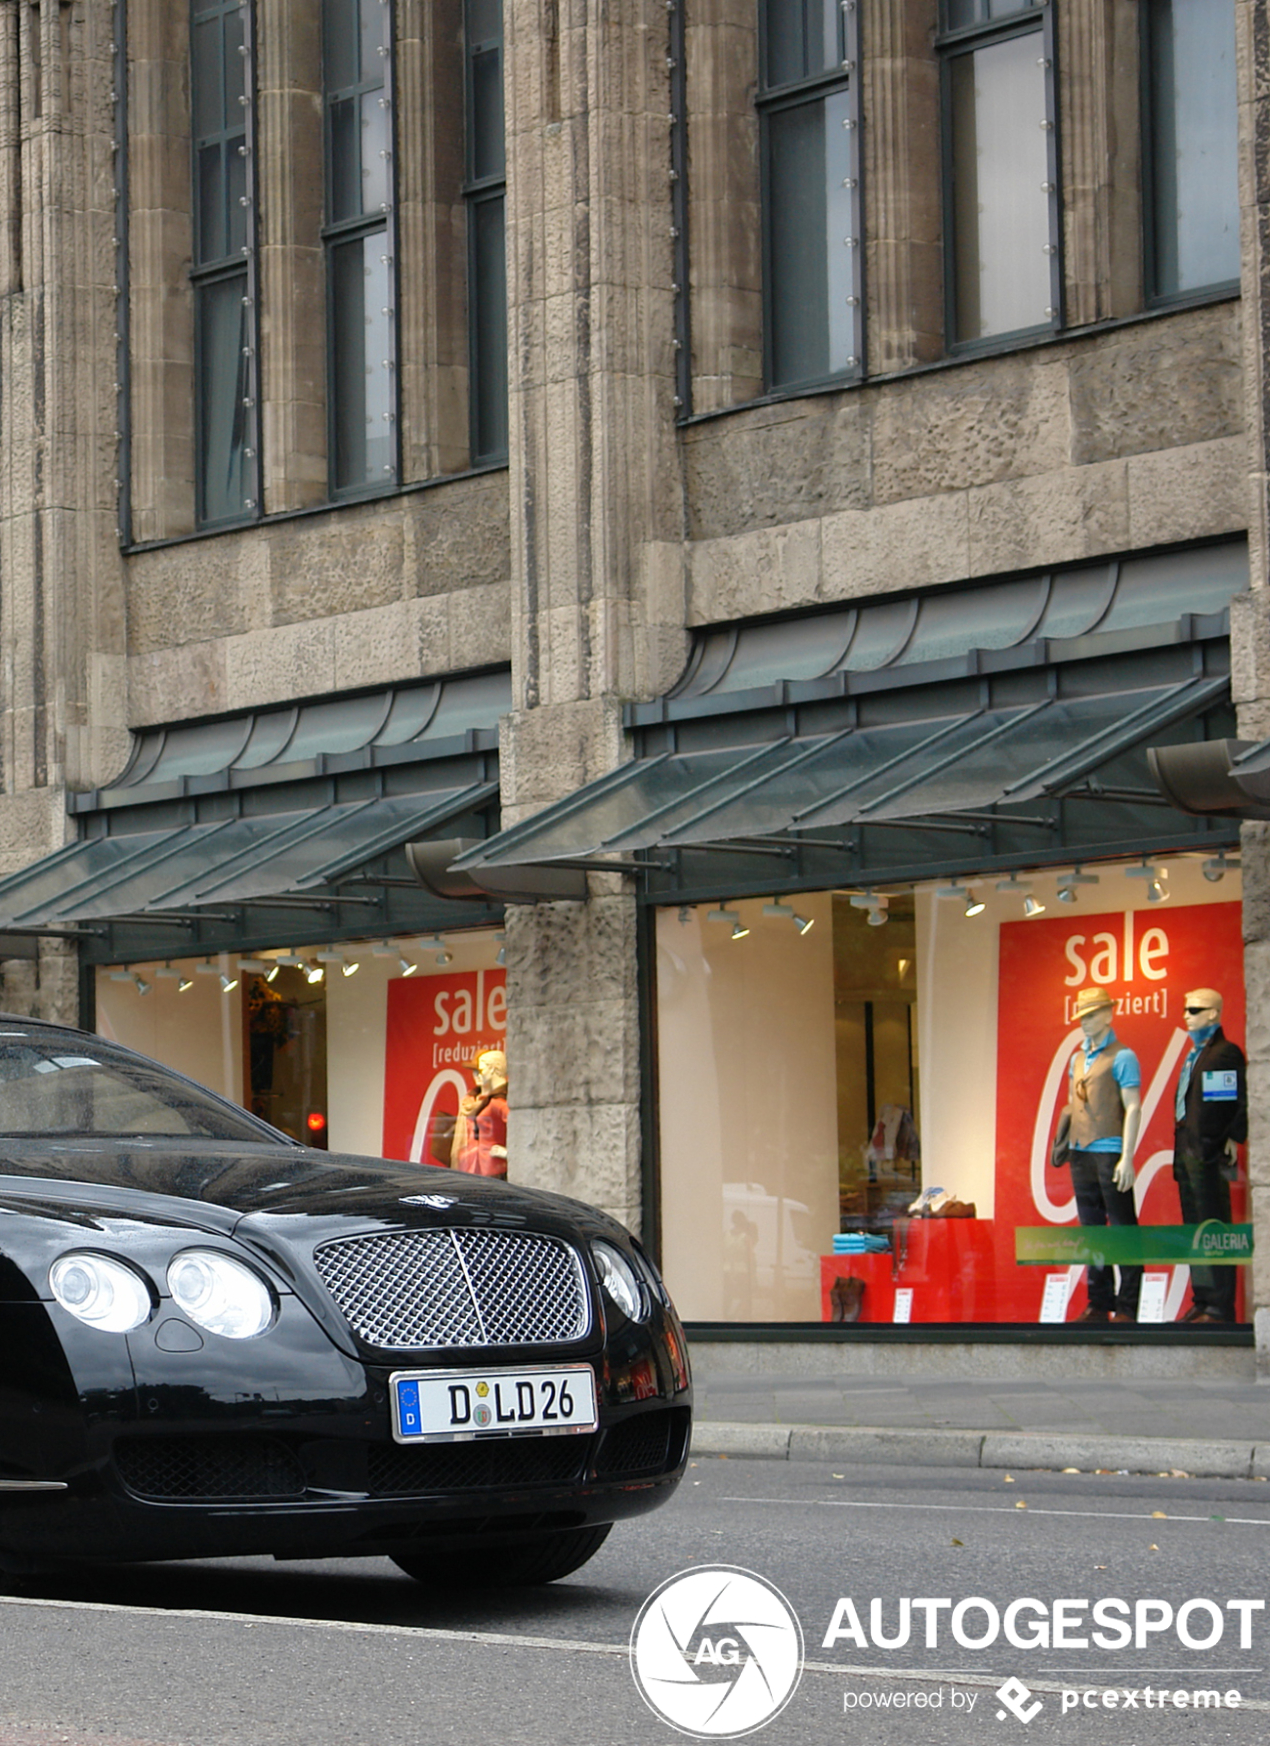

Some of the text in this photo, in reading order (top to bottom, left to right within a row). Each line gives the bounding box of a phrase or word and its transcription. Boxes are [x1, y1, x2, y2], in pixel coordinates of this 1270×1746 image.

[1064, 911, 1170, 987] sale
[433, 970, 507, 1036] sale
[1064, 988, 1168, 1025] [rziert]
[1203, 1233, 1249, 1250] GALERIA
[406, 1413, 415, 1425] D
[448, 1379, 574, 1424] D LD 26
